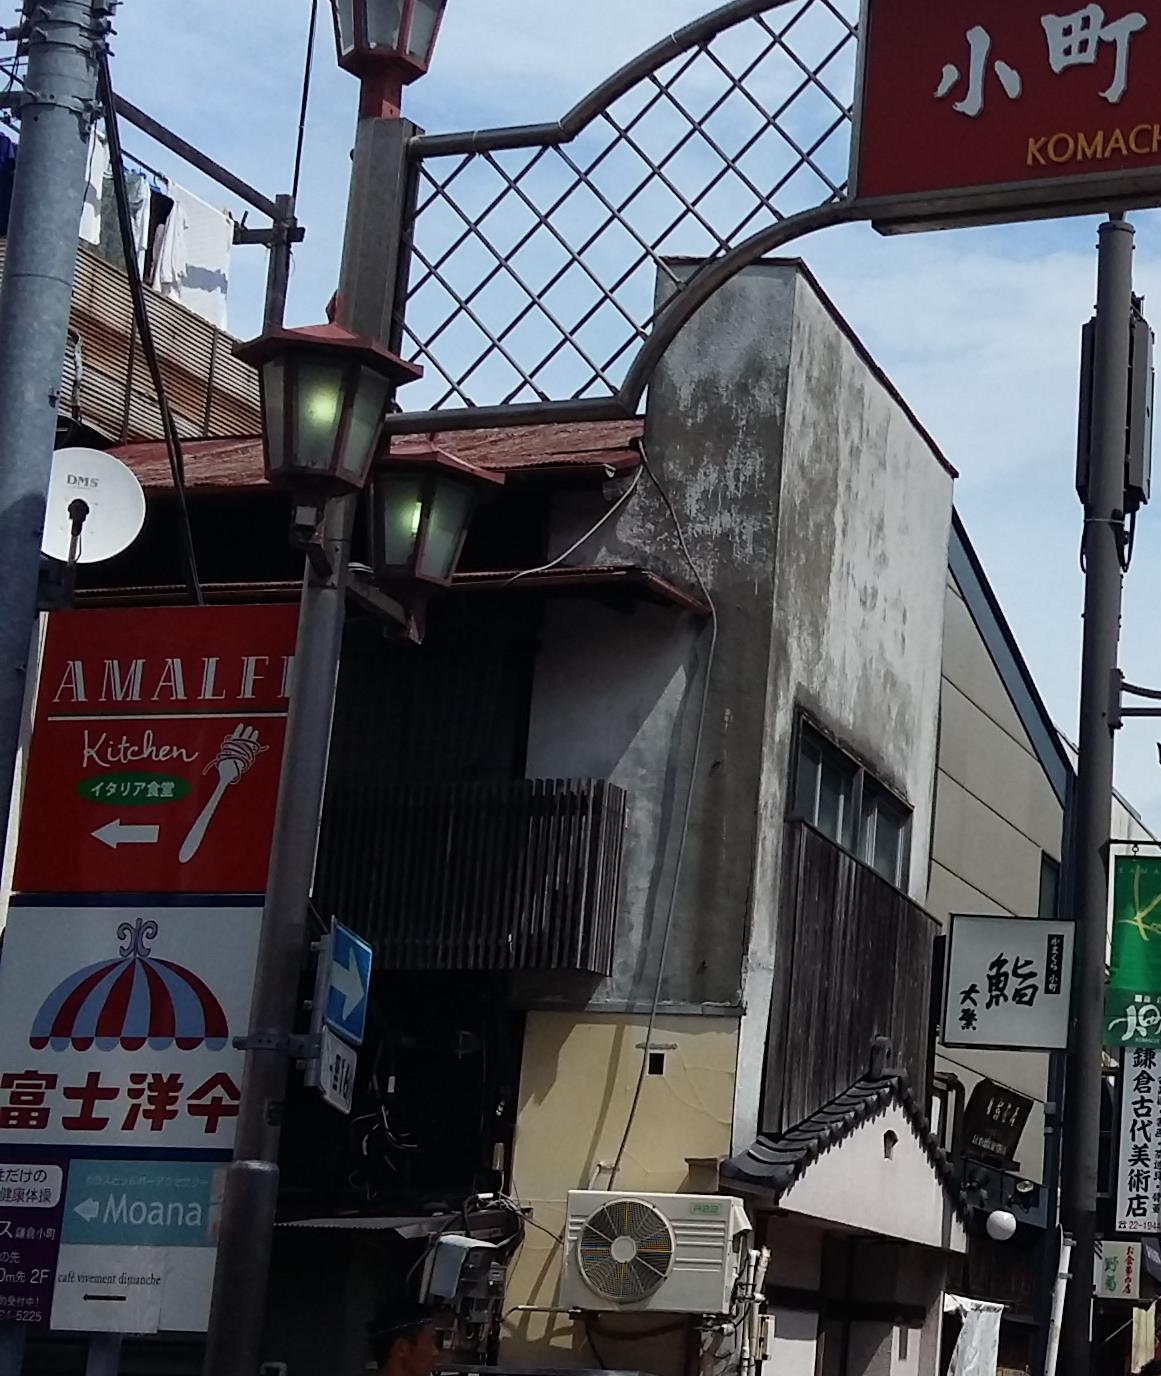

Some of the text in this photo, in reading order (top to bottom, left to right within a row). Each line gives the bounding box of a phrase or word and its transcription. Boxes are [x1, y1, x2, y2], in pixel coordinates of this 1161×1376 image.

[81, 729, 199, 768] Kitchen
[90, 780, 176, 799] イタリア食堂
[985, 952, 1039, 1010] 鮨
[1126, 1047, 1157, 1218] 鎌倉古代美術店
[103, 1192, 203, 1226] Moana
[30, 1268, 51, 1284] 2F
